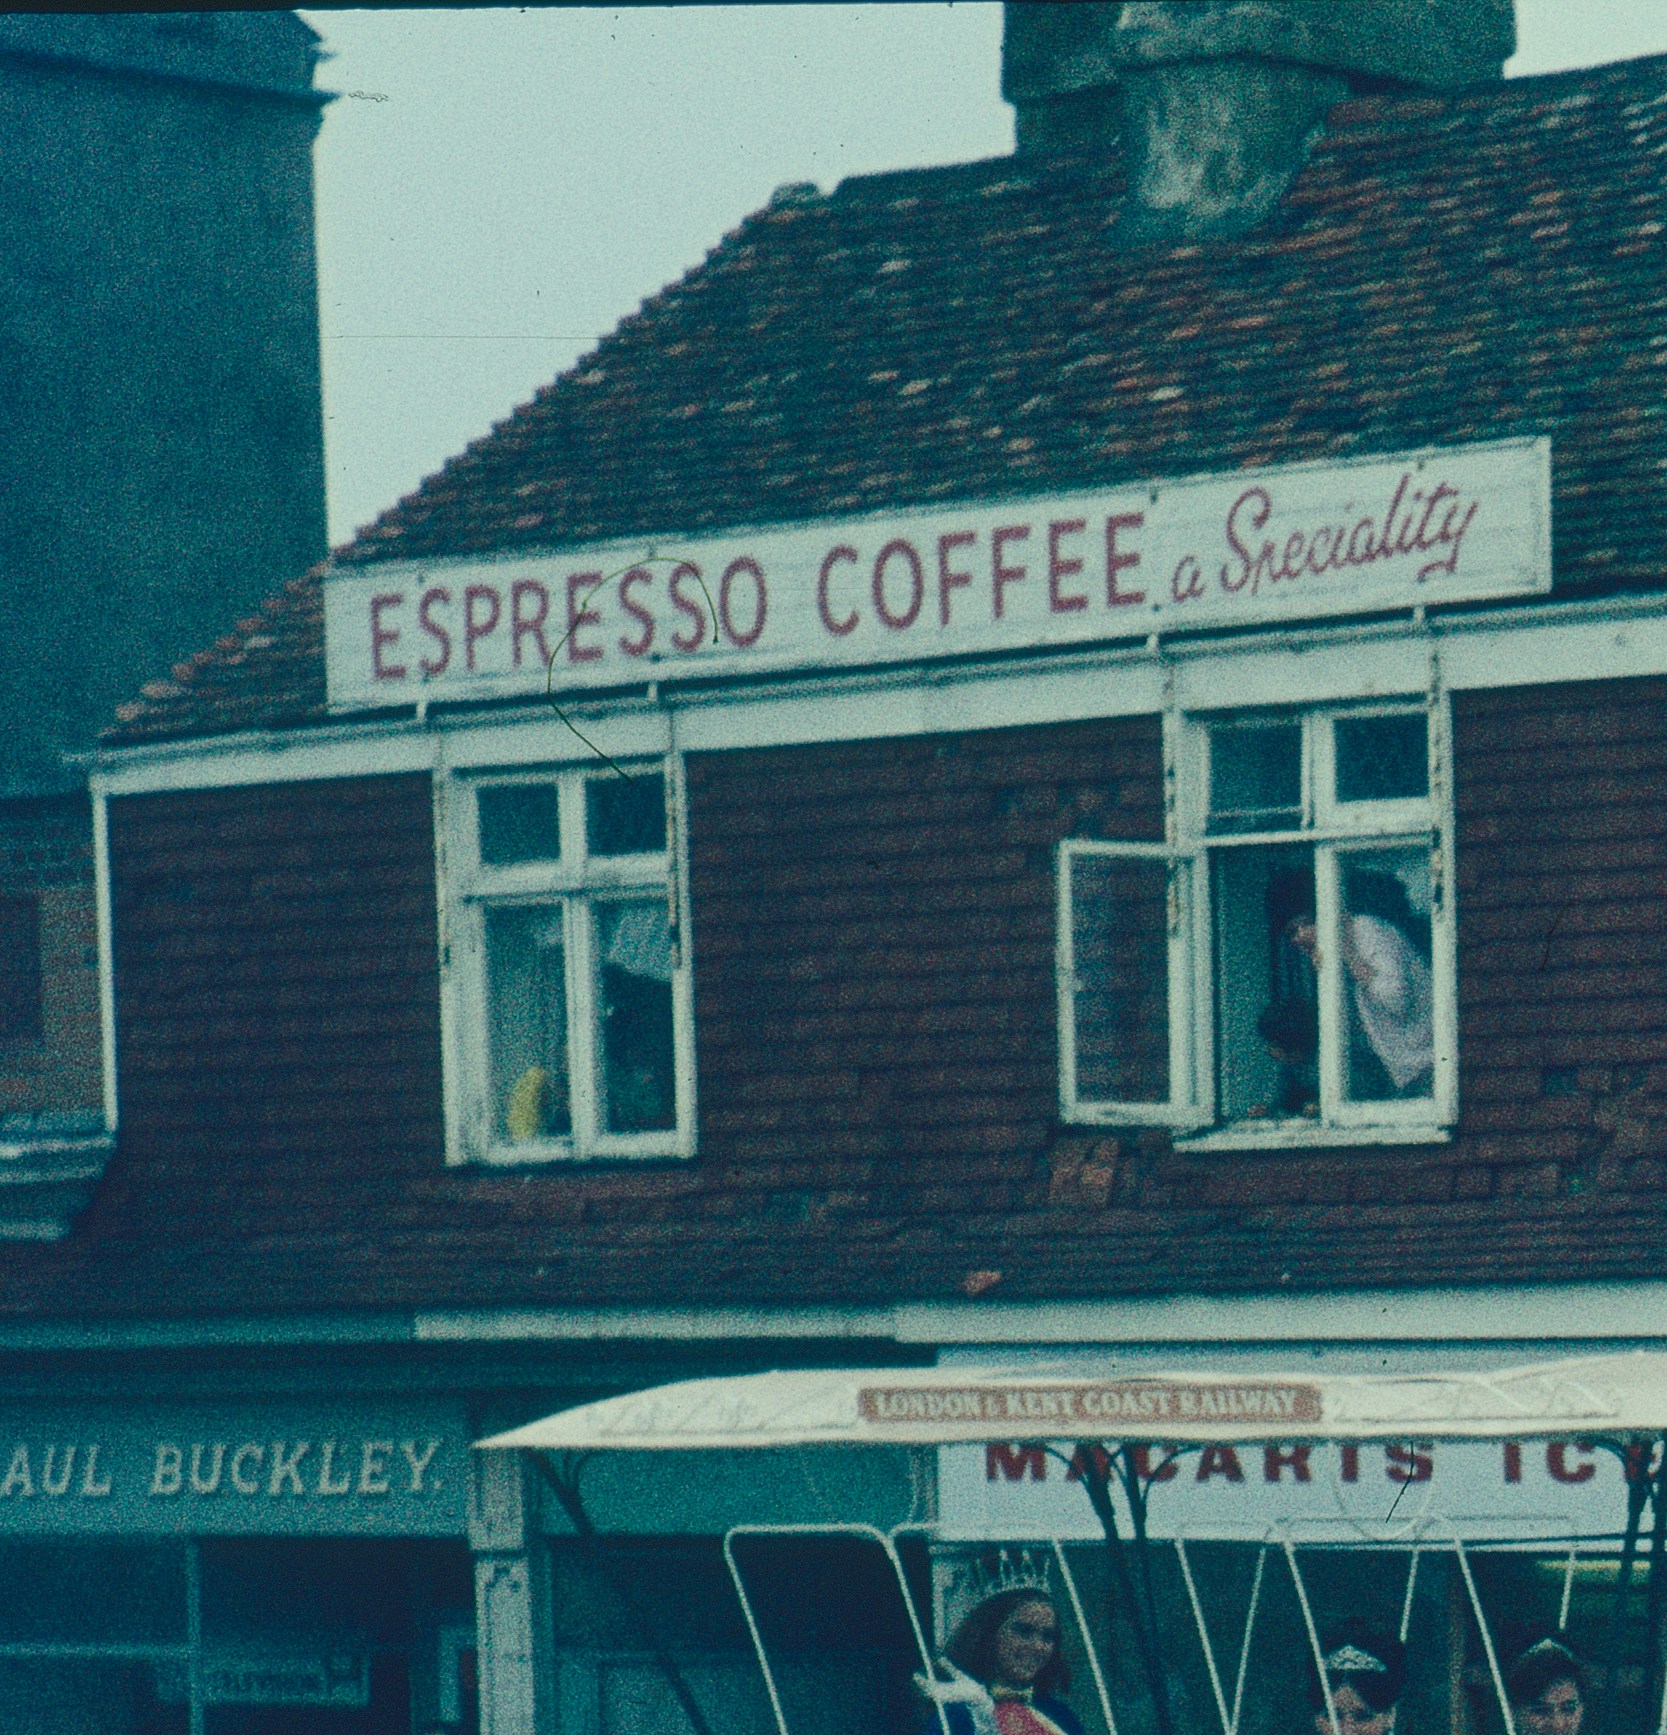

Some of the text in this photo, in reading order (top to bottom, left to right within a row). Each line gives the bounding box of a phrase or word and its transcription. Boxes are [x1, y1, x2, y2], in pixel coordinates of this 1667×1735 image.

[370, 472, 1479, 682] ESPRESSO COFFEE a Speciality
[875, 1391, 981, 1418] LONDON
[1005, 1391, 1076, 1417] KENT
[1081, 1389, 1171, 1415] COAST
[1177, 1388, 1297, 1415] RAILWAY
[0, 1443, 112, 1497] AUL
